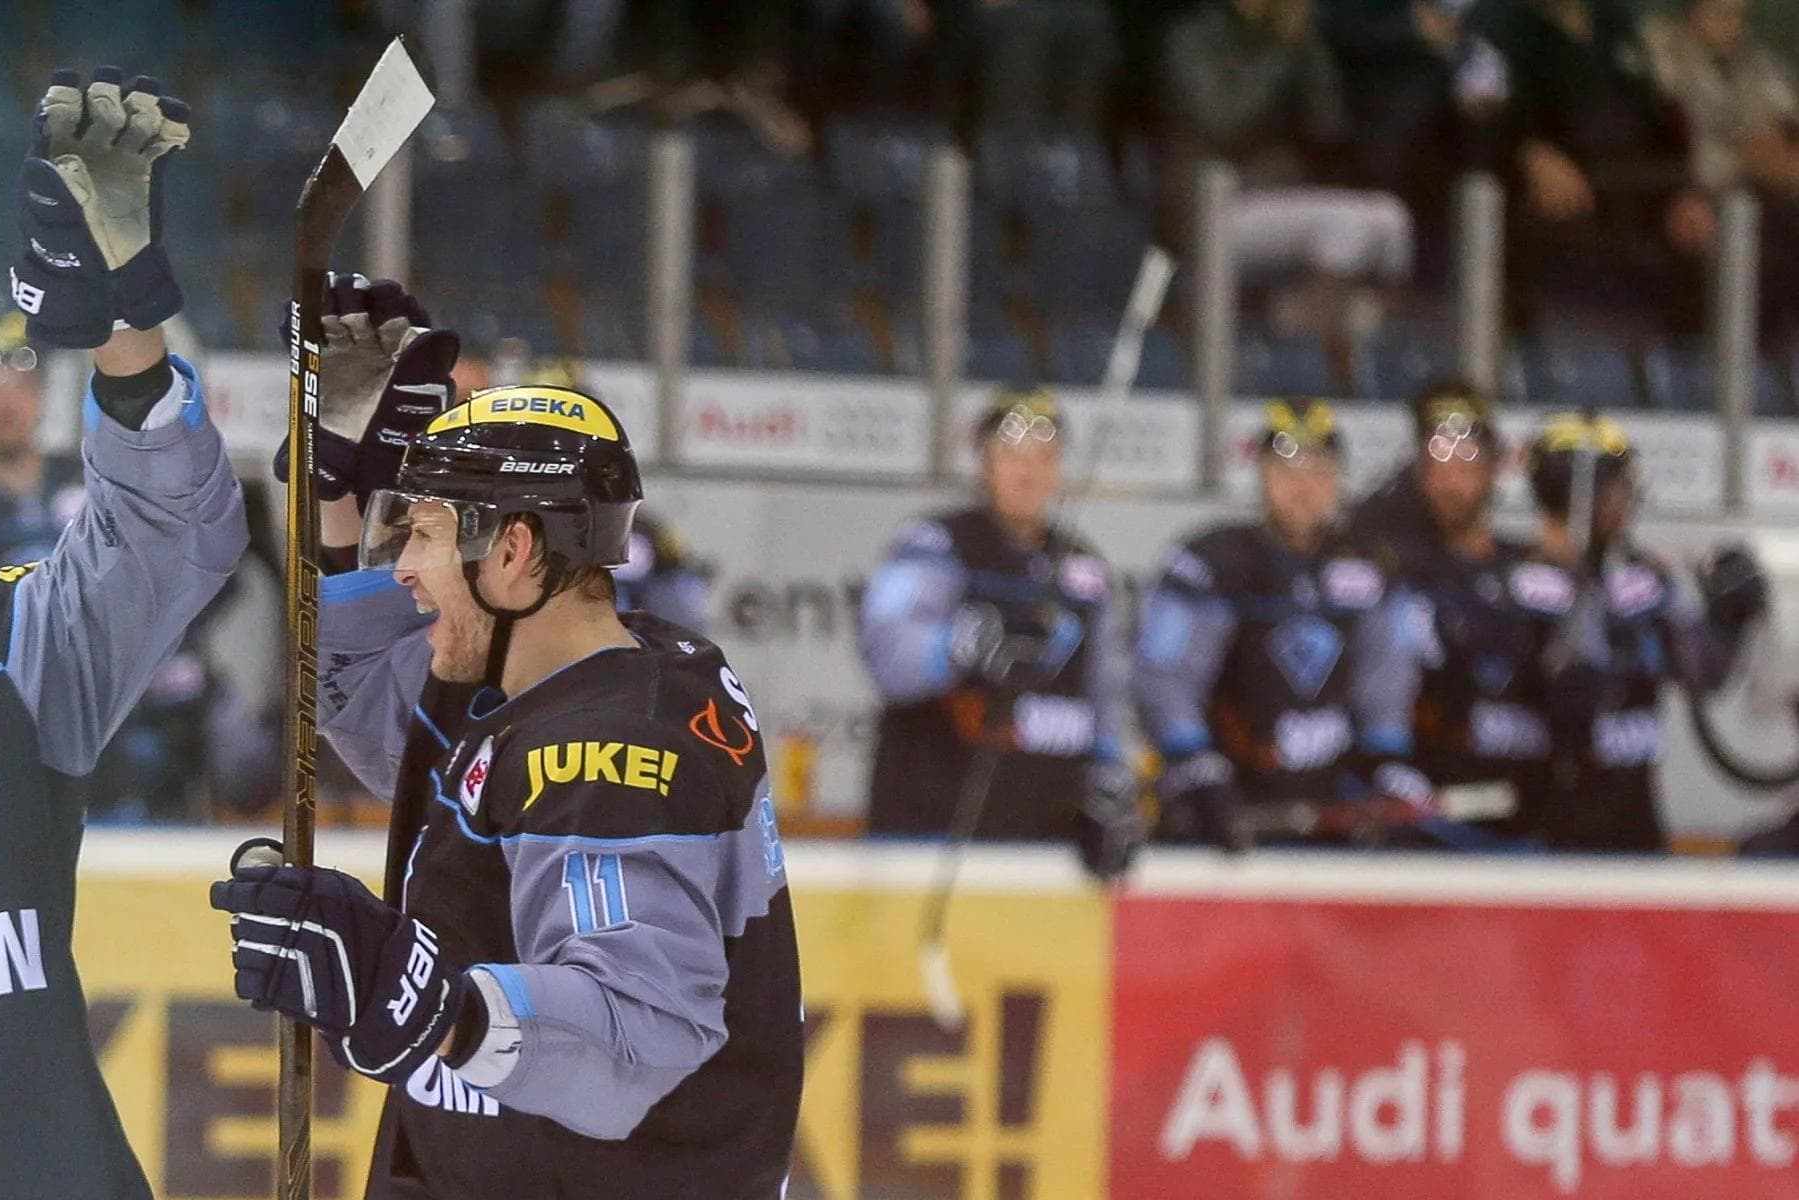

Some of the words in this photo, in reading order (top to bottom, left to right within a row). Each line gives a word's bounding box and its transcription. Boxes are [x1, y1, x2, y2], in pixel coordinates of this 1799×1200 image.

[491, 397, 587, 421] EDEKA
[499, 461, 576, 475] BAUER
[522, 741, 679, 812] JUKE!
[562, 849, 629, 935] 11
[1157, 1034, 1468, 1164] Audi
